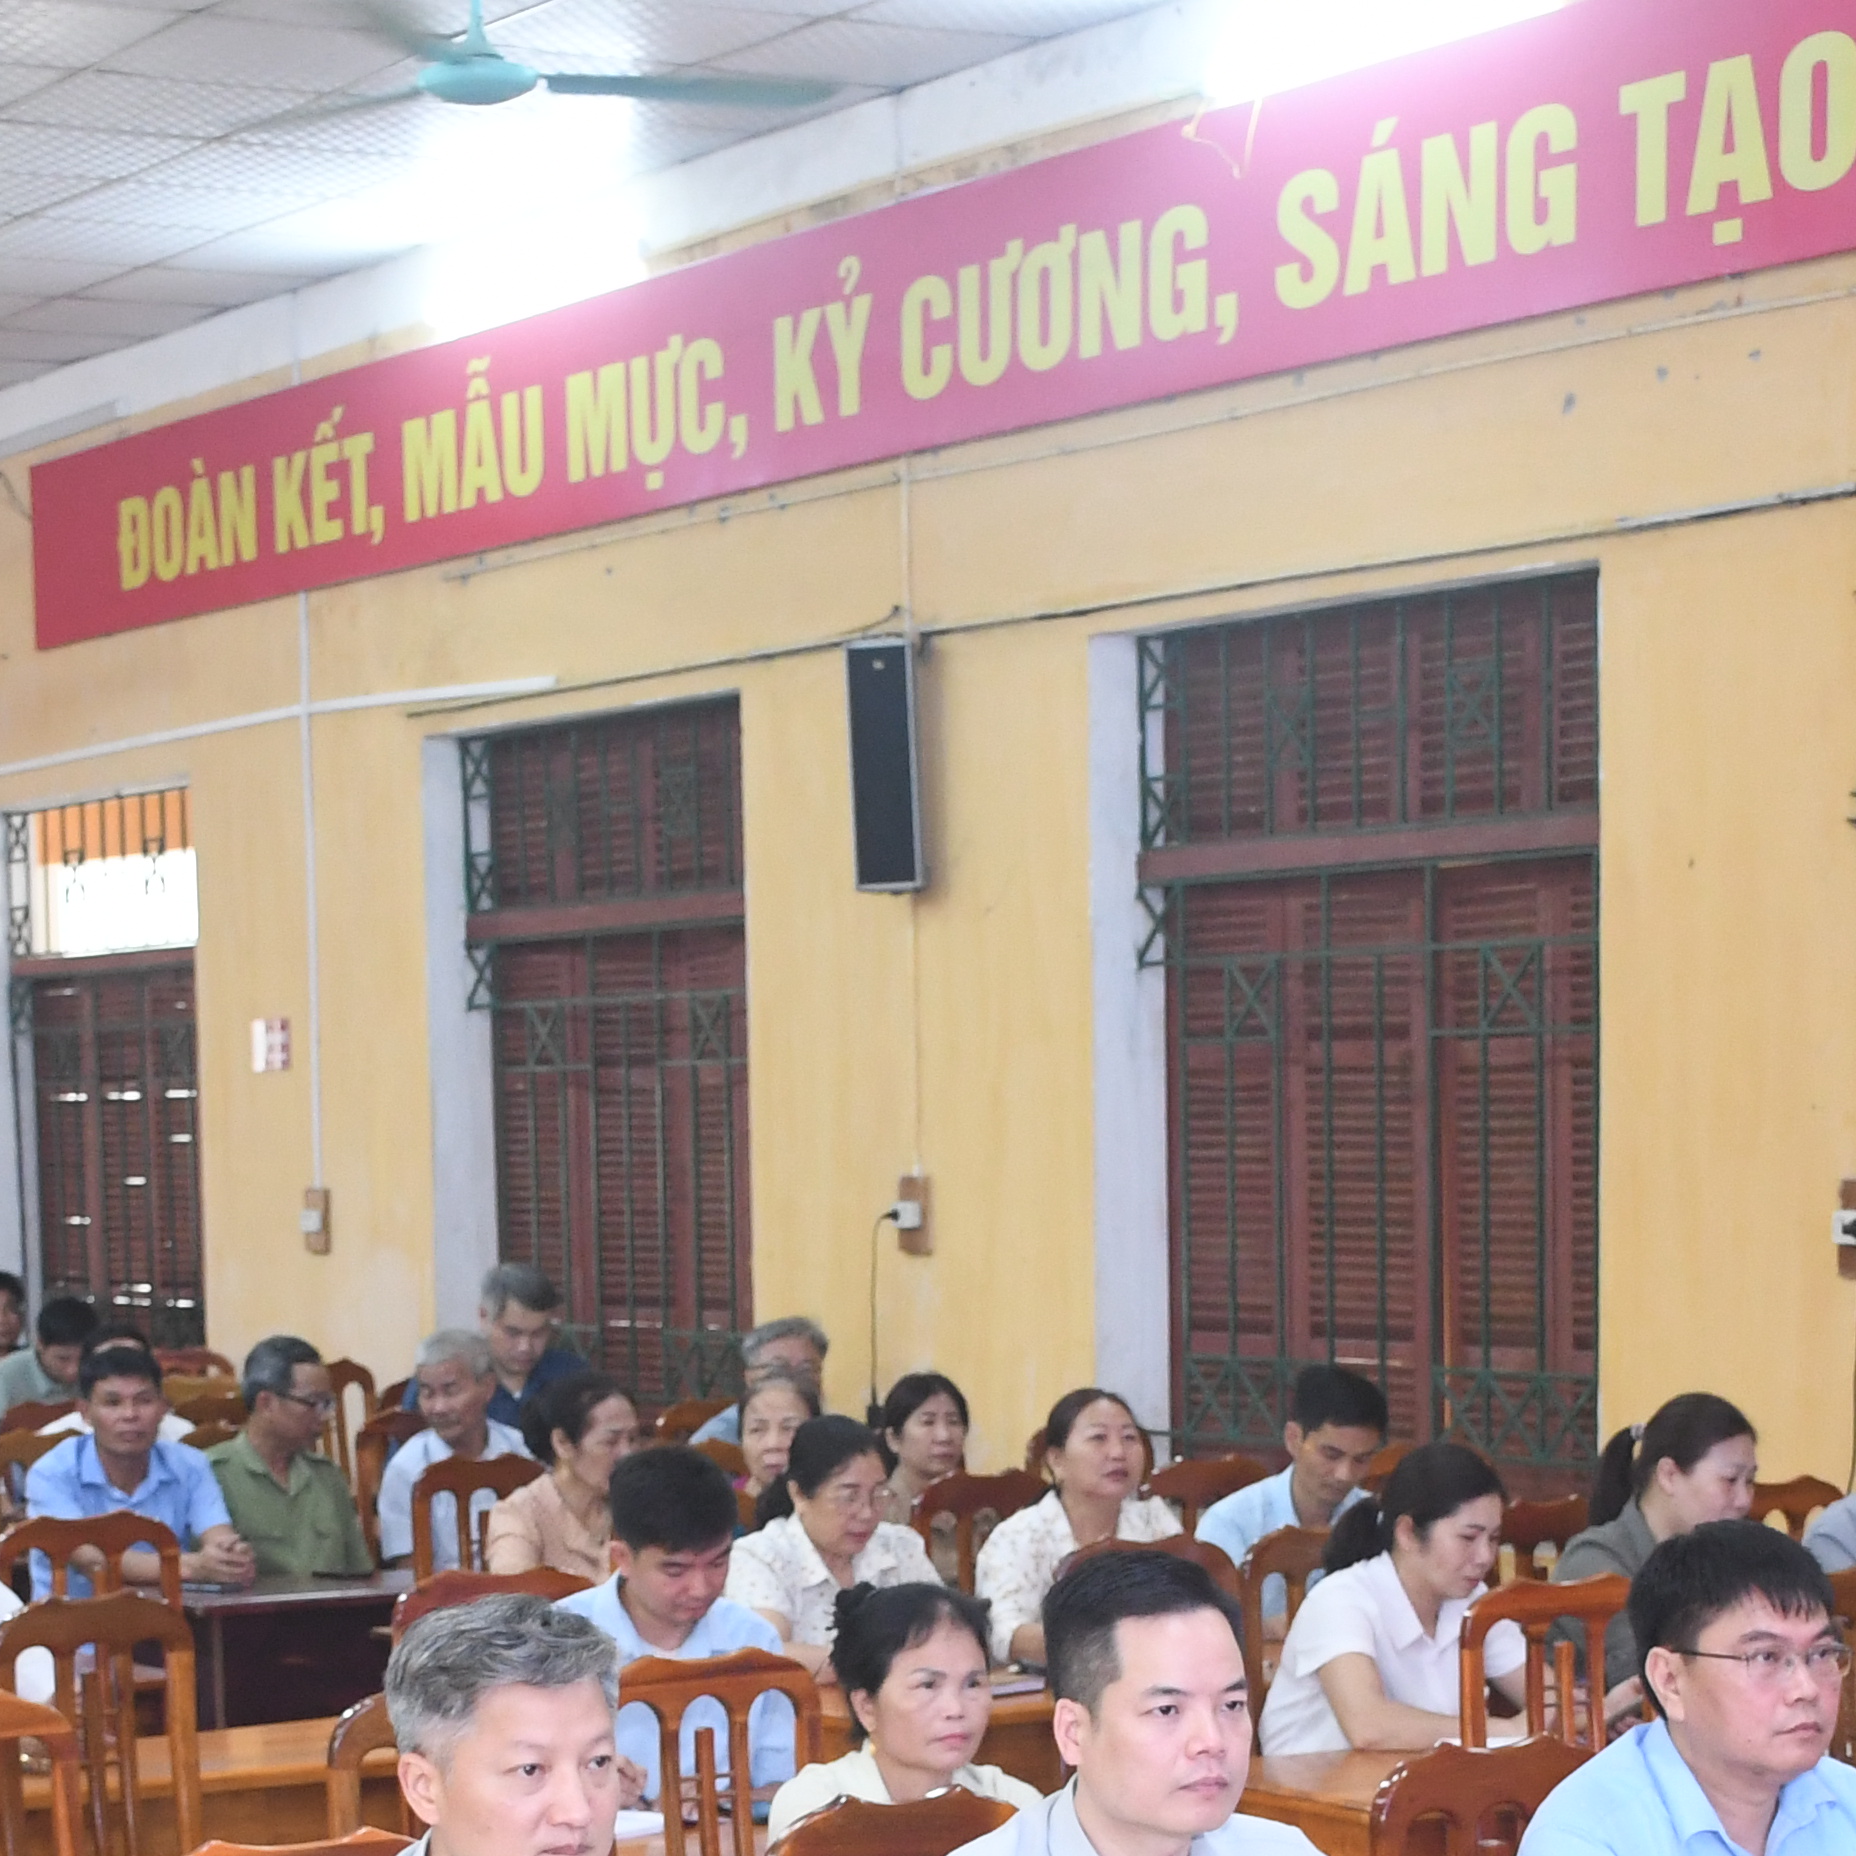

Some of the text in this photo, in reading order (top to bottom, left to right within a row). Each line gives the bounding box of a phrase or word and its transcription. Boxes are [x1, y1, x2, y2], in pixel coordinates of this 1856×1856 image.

[117, 457, 257, 592] ĐOÀN
[272, 404, 386, 555] KẾT,
[400, 355, 544, 523] MẪU
[564, 333, 748, 491] MỰC,
[772, 254, 873, 433] KỶ
[900, 203, 1241, 401] CƯƠNG,
[1274, 102, 1579, 310] SÁNG
